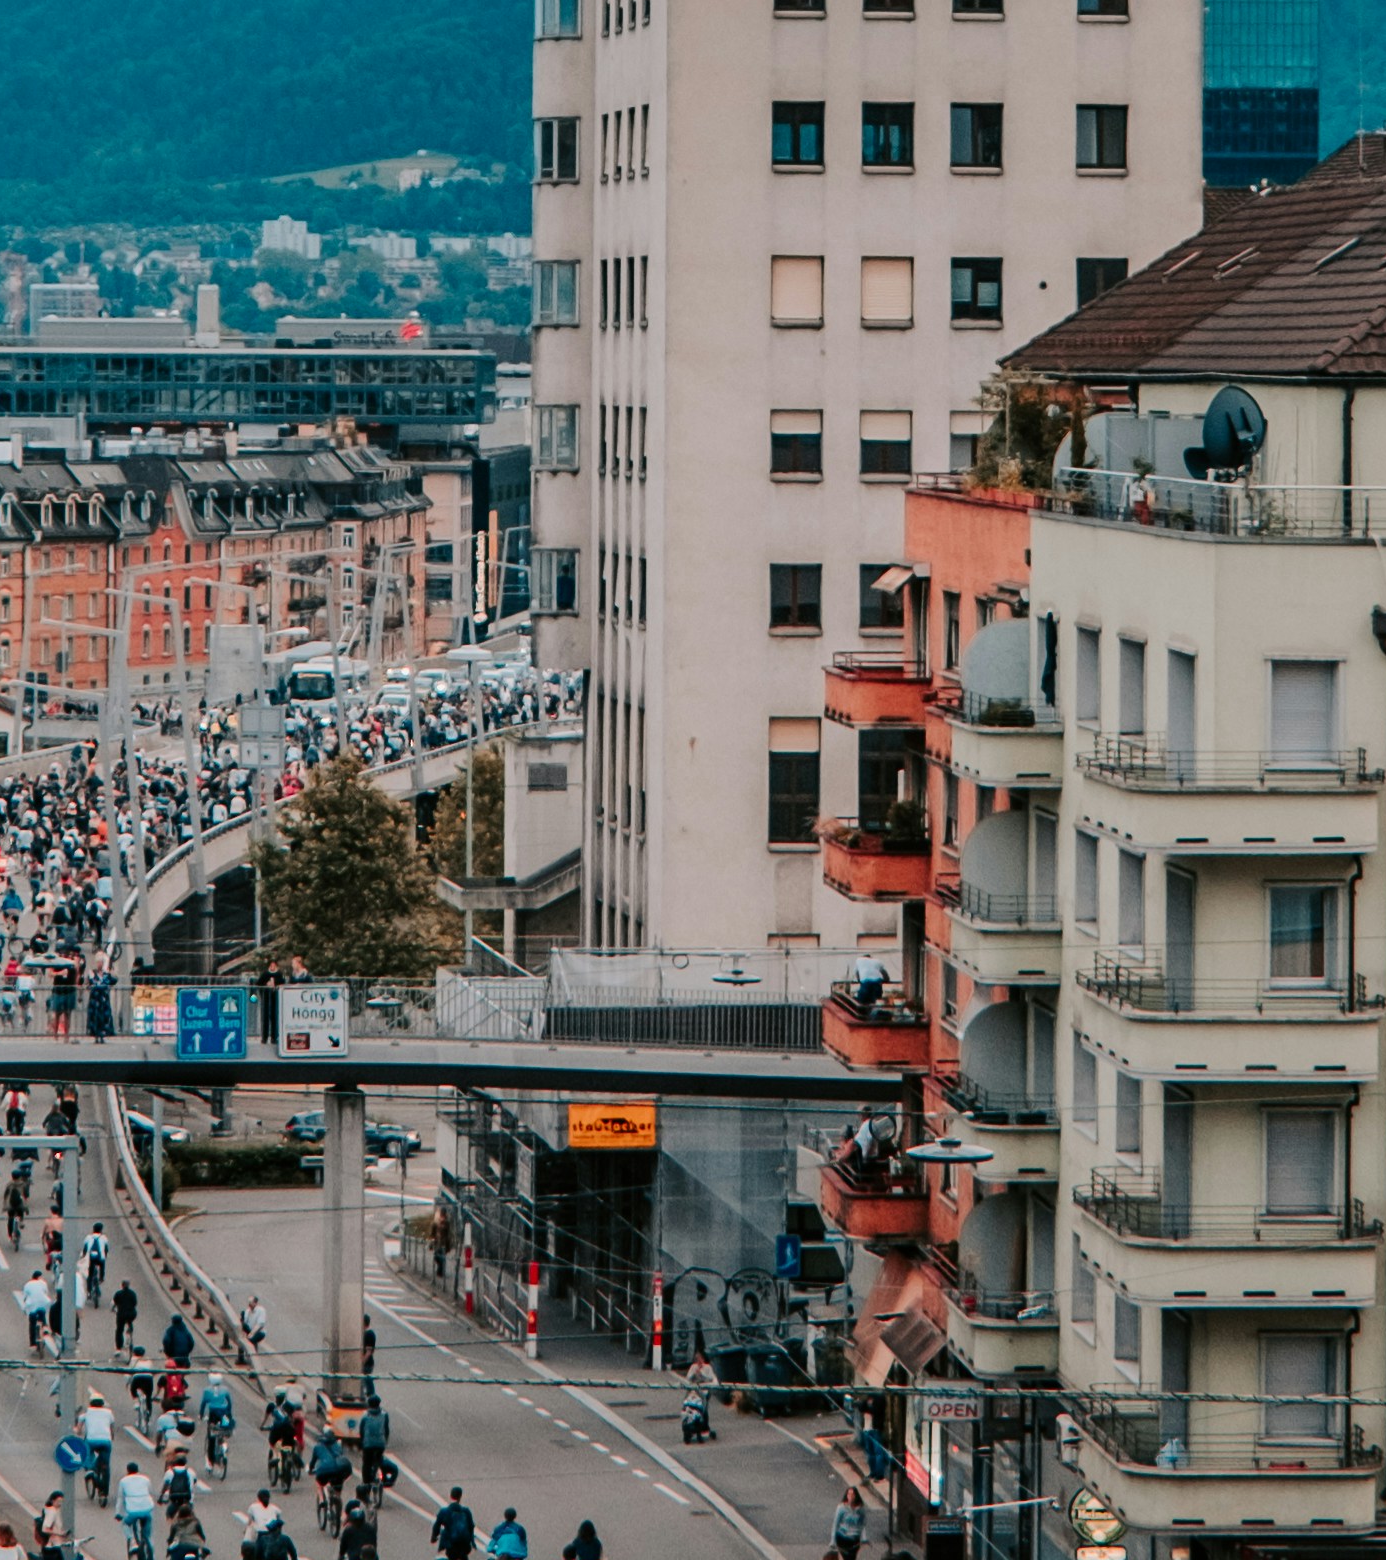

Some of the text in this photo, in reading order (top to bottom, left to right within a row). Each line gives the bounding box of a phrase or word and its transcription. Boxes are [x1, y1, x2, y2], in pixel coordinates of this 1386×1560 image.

[301, 990, 326, 1006] City
[185, 1006, 208, 1018] Chur
[292, 1007, 335, 1022] Höngg
[181, 1018, 213, 1029] Luzern
[218, 1017, 241, 1029] Bern
[928, 1402, 979, 1418] OPEN
